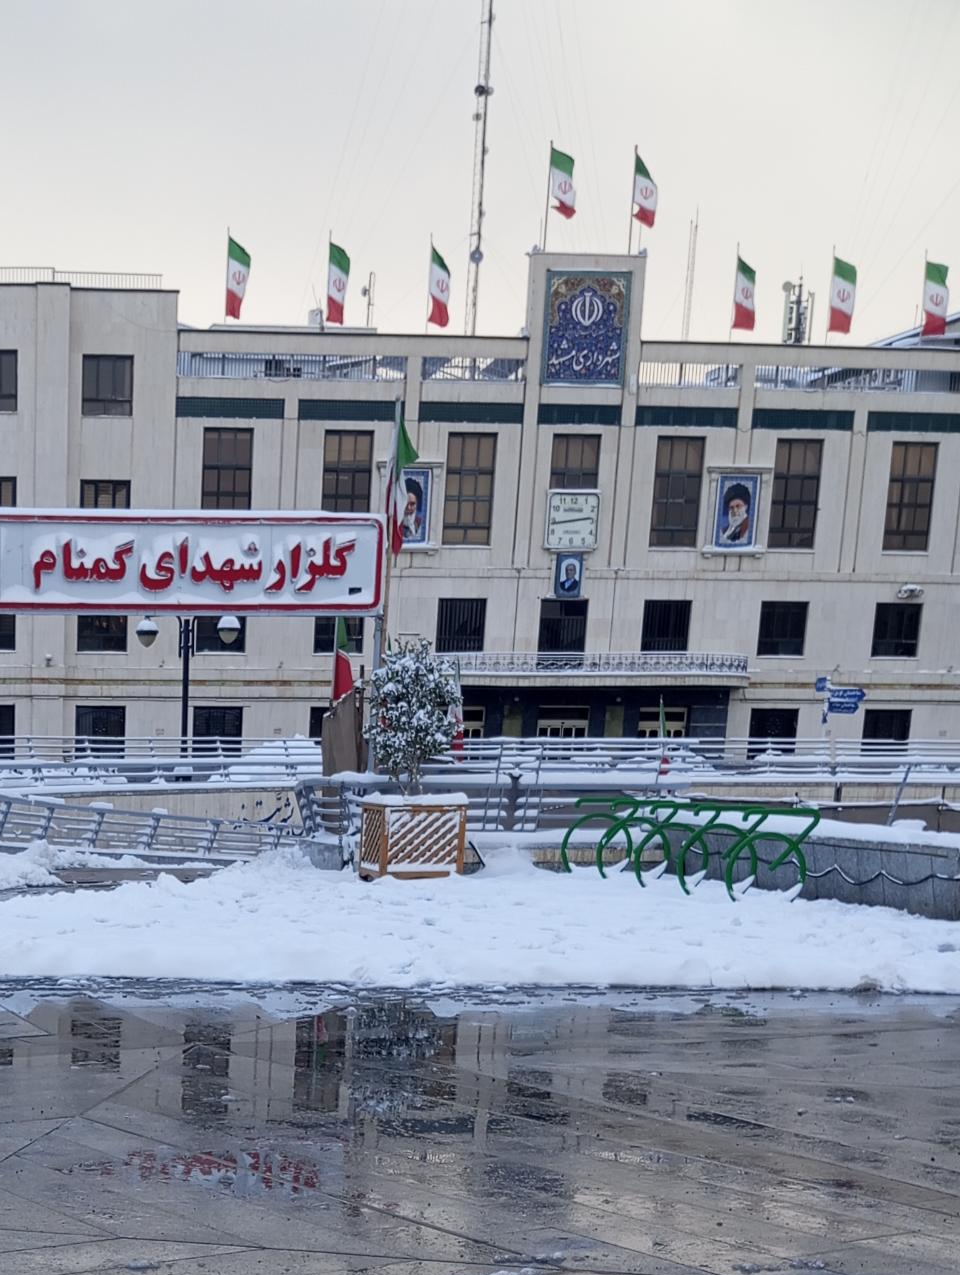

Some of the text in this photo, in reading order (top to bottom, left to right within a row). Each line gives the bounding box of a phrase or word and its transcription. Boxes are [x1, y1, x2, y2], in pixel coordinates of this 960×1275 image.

[548, 339, 620, 371] شهرداری مشهد
[552, 504, 561, 513] 10
[570, 496, 578, 505] 12
[33, 536, 358, 593] گلزار شهدای گمنام
